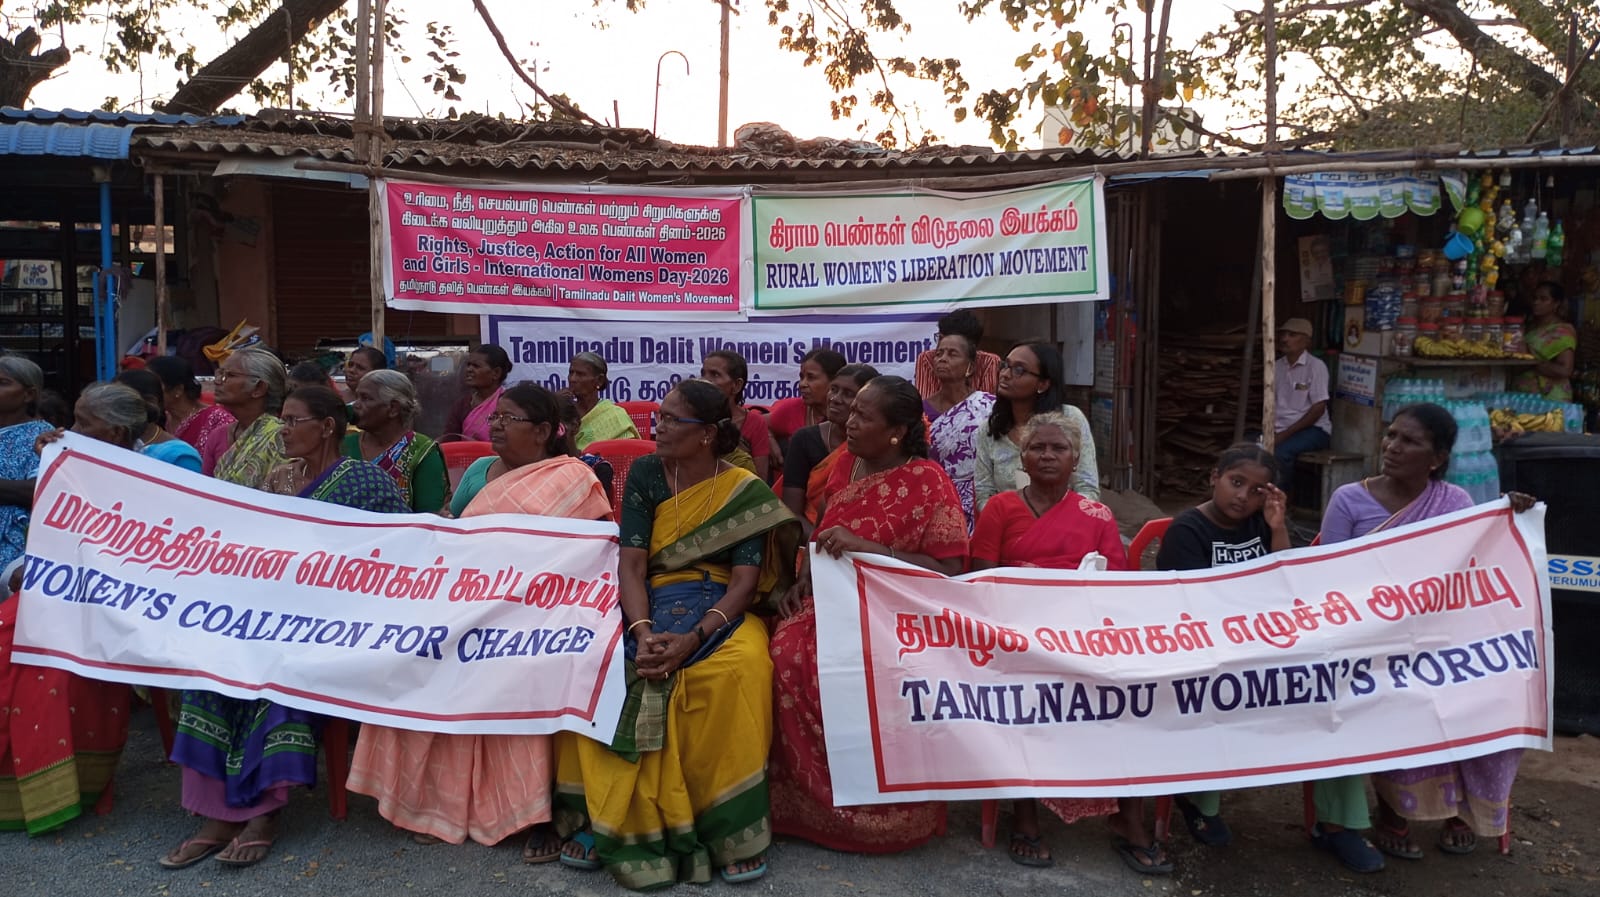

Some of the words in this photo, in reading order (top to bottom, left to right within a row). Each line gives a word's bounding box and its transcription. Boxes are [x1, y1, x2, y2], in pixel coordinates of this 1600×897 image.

[403, 192, 449, 211] உரிமை,
[452, 191, 475, 213] நீதி,
[478, 196, 539, 215] செயல்பாடு
[542, 199, 597, 216] பெண்கள்
[600, 201, 640, 222] மற்றும்
[643, 204, 721, 223] சிறுமிகளுக்கு
[401, 211, 449, 228] கிடைக்க
[451, 215, 528, 237] வலியுறுத்தும்
[531, 220, 565, 234] அகில
[568, 222, 599, 236] உலக
[602, 222, 656, 240] பெண்கள்
[659, 224, 726, 243] தினம்-2026
[769, 216, 819, 252] கிராம
[824, 215, 906, 248] பெண்கள்
[911, 214, 994, 248] விடுதலை
[1000, 201, 1079, 237] இயக்கம்
[418, 235, 473, 256] Rights,
[477, 239, 540, 262] Justice,
[544, 242, 595, 261] Action
[600, 245, 621, 262] for
[625, 247, 646, 264] All
[650, 248, 707, 265] Women
[403, 257, 427, 272] and
[432, 257, 470, 274] Girls
[484, 259, 584, 280] International
[589, 265, 653, 283] Womens
[658, 268, 729, 288] Day-2026
[766, 262, 819, 289] RURAL
[823, 258, 897, 287] WOMEN'S
[901, 251, 994, 281] LIBERATION
[999, 245, 1089, 275] MOVEMENT
[438, 280, 465, 296] தலித்
[466, 282, 509, 296] பெண்கள்
[511, 283, 551, 298] இயக்கம்
[559, 288, 610, 300] Tamilnadu
[613, 291, 636, 302] Dalit
[638, 291, 682, 304] Women's
[684, 292, 734, 304] Movement
[640, 337, 694, 364] Dalit
[43, 491, 299, 579] மாற்றத்திற்கான
[295, 548, 449, 601] பெண்கள்
[1216, 545, 1260, 562] HAPPY
[1549, 576, 1600, 588] ERUMU
[23, 554, 177, 620] WOMEN'S
[178, 600, 373, 647] COALITION
[371, 624, 449, 660] FOR
[457, 626, 595, 663] CHANGE
[896, 607, 1029, 667] தமிழக
[1034, 613, 1214, 657] பெண்கள்
[1222, 591, 1362, 649] எழுச்சி
[1367, 556, 1522, 622] அமைப்பு
[902, 680, 1157, 725] TAMILNADU
[1172, 656, 1376, 715] WOMEN'S
[1387, 630, 1539, 688] FORUM
